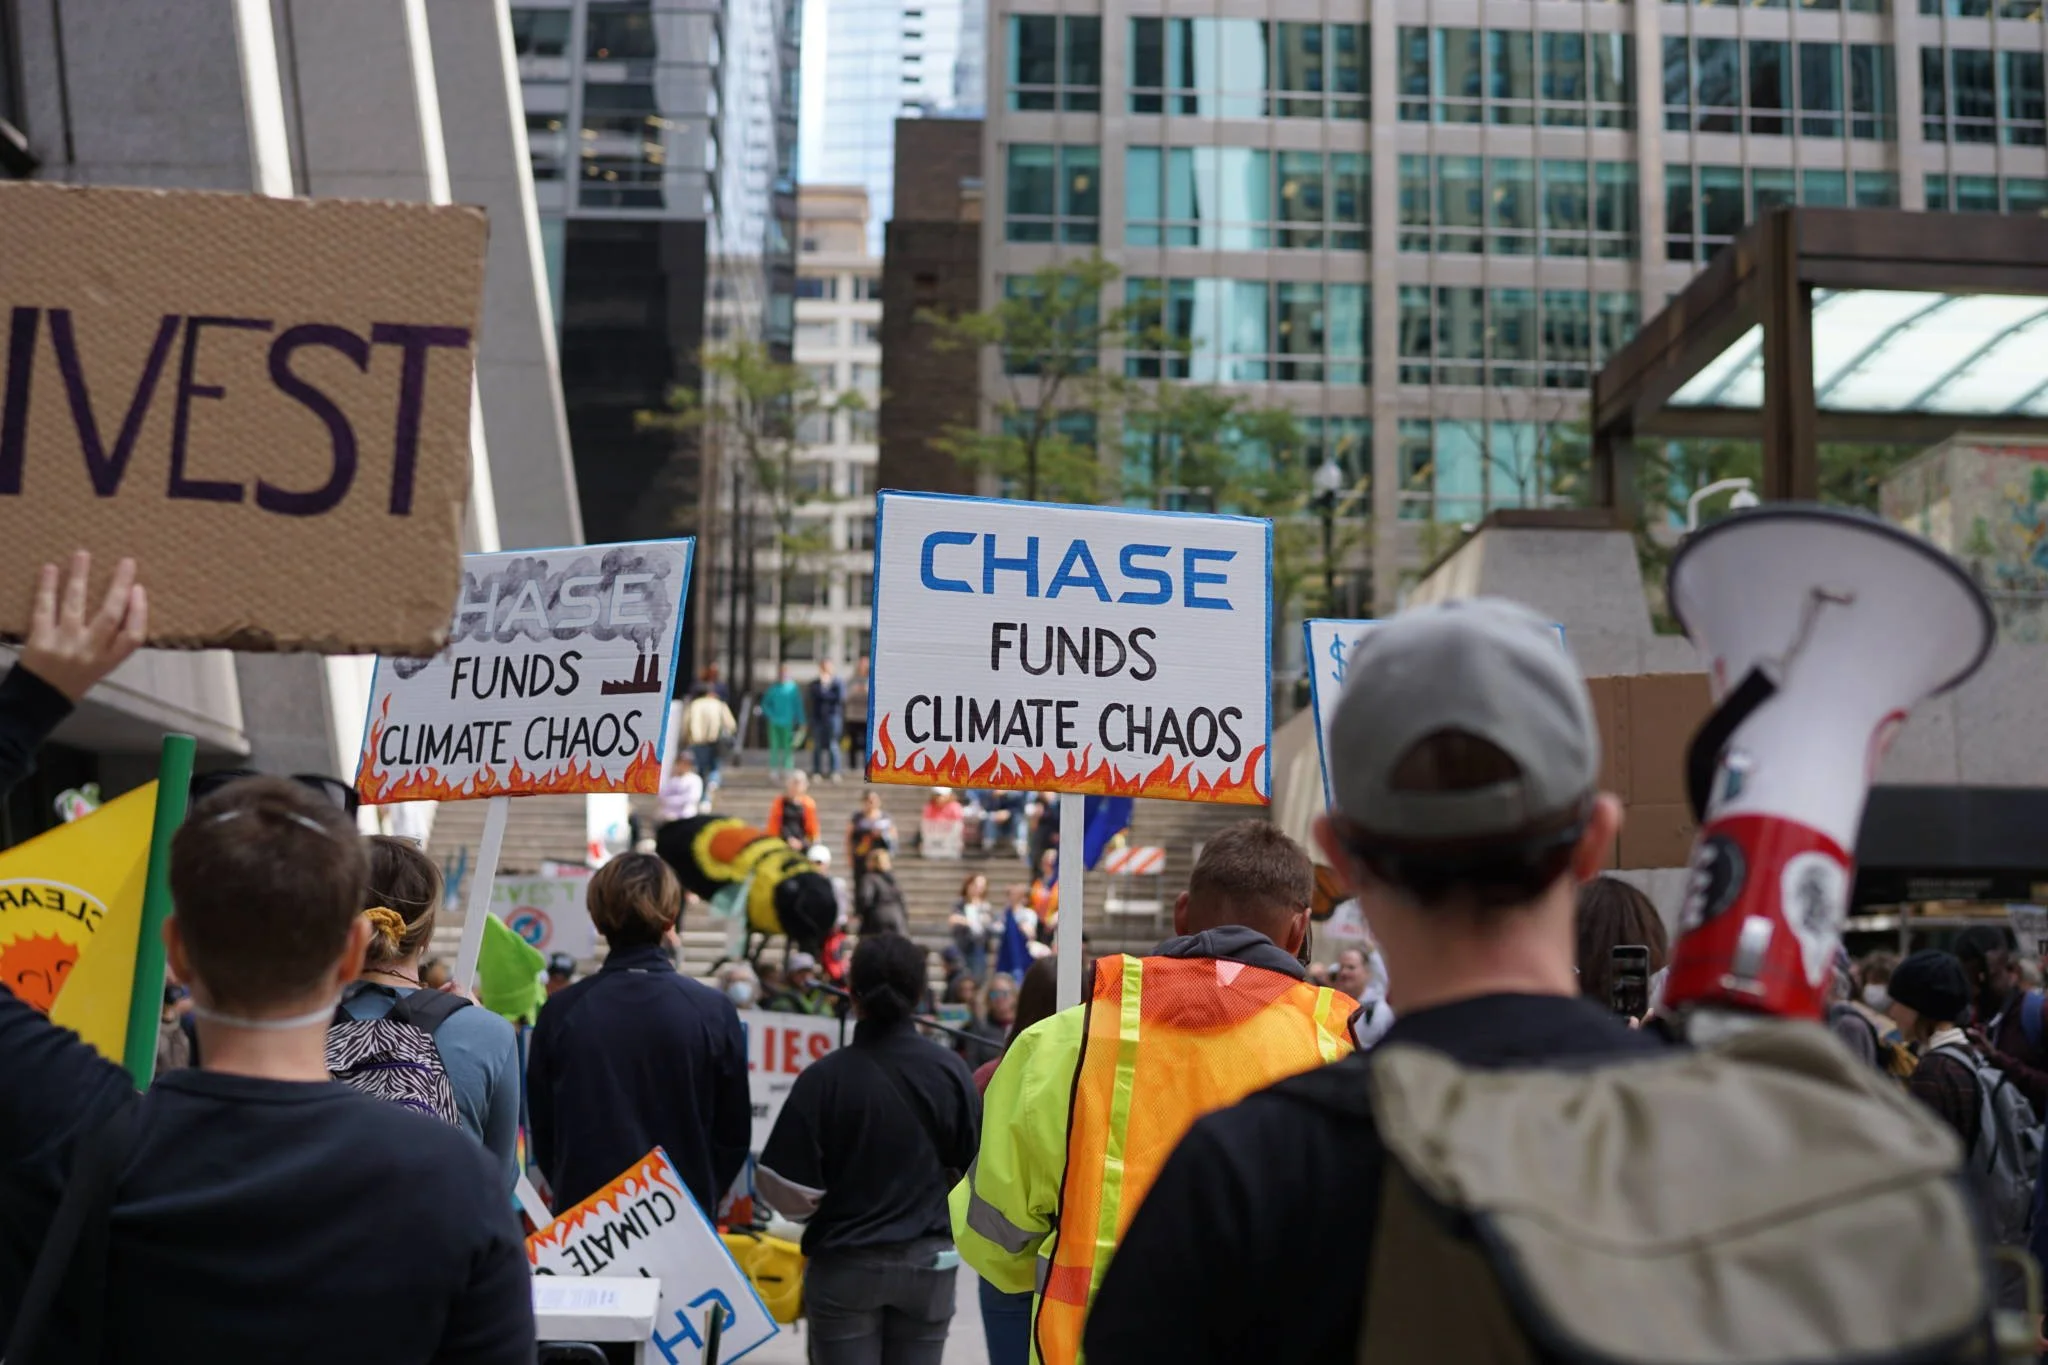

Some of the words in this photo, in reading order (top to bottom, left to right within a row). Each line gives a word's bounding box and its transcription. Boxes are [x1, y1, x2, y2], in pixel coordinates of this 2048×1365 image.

[920, 530, 1238, 611] CHASE
[451, 572, 656, 635] HASE
[450, 650, 583, 700] FUNDS
[990, 622, 1157, 682] FUNDS
[379, 720, 512, 766] CLIMATE
[523, 710, 643, 762] CHAOS
[904, 694, 1079, 750] CLIMATE
[1098, 702, 1243, 763] CHAOS
[748, 1026, 832, 1076] IES
[561, 1191, 676, 1276] CLIMATE
